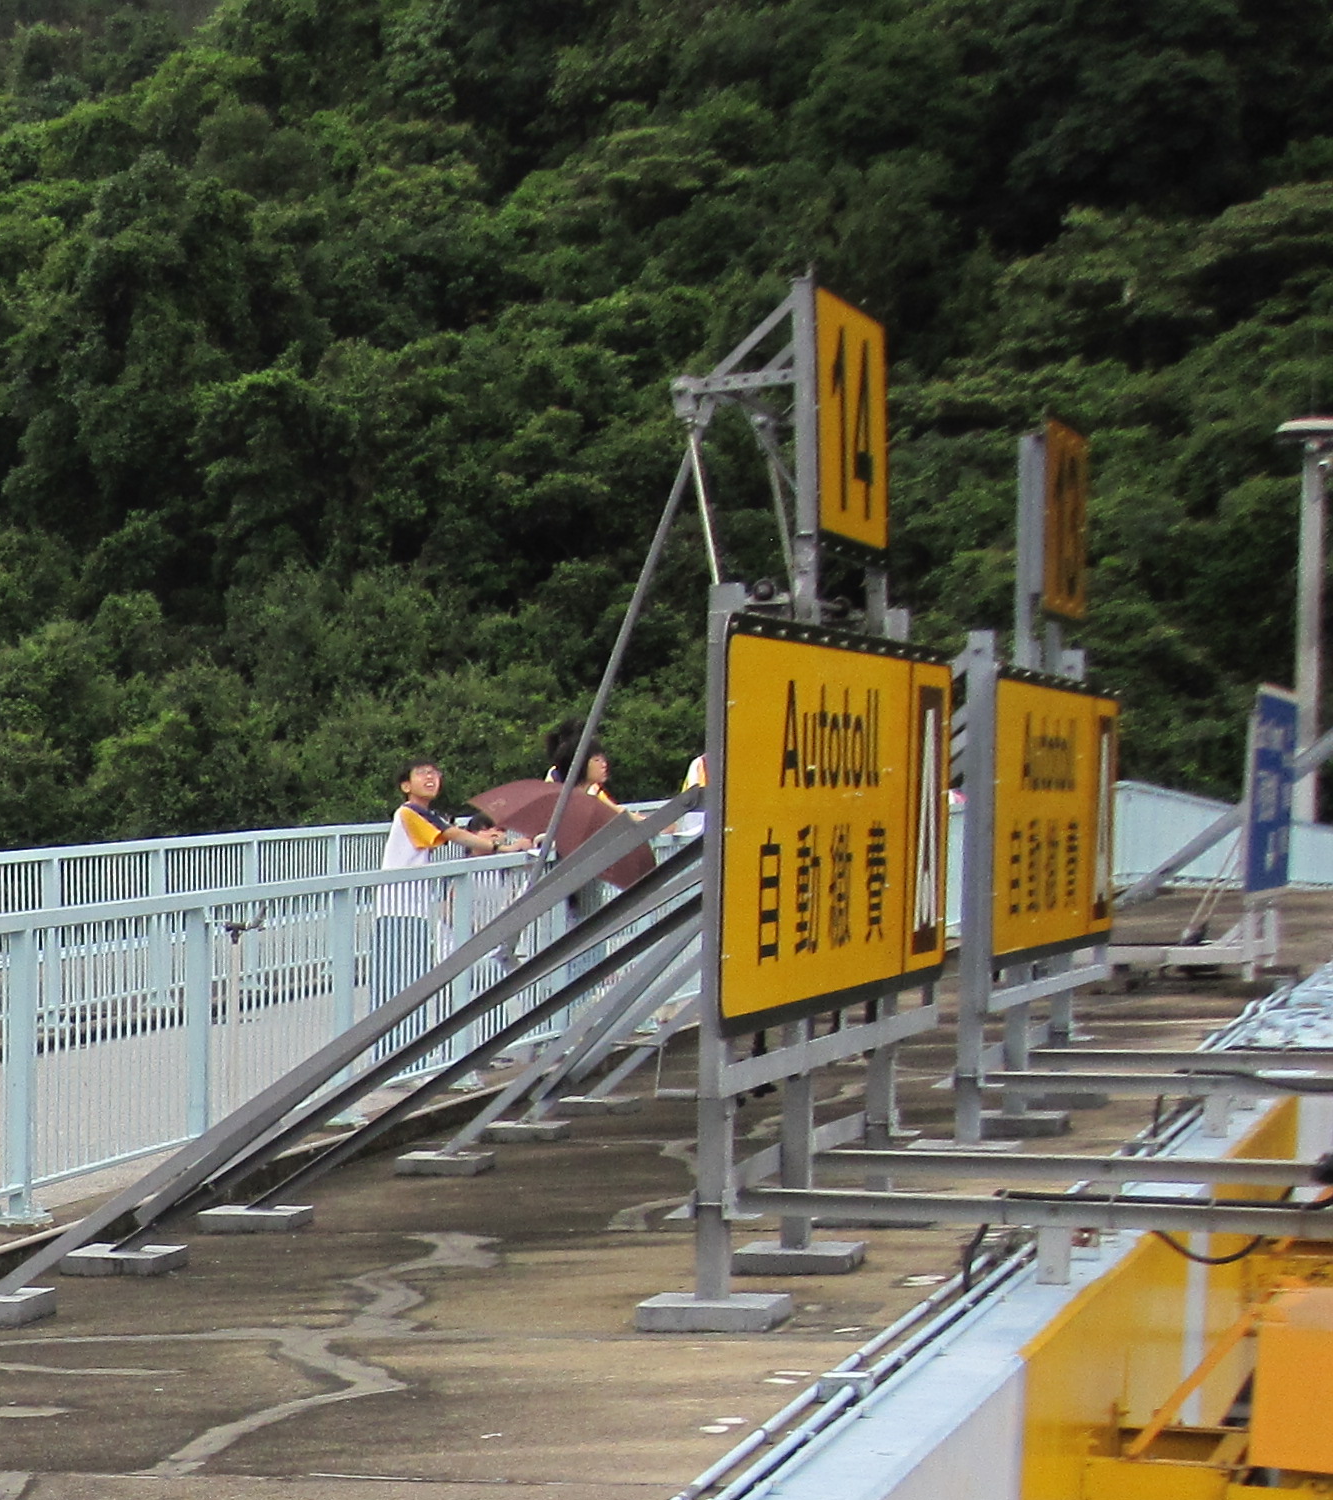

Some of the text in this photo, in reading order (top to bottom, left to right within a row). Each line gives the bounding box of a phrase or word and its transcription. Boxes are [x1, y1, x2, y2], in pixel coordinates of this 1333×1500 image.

[831, 325, 873, 522] 14
[780, 679, 880, 789] Autotoll
[758, 820, 886, 965] 自動繳費
